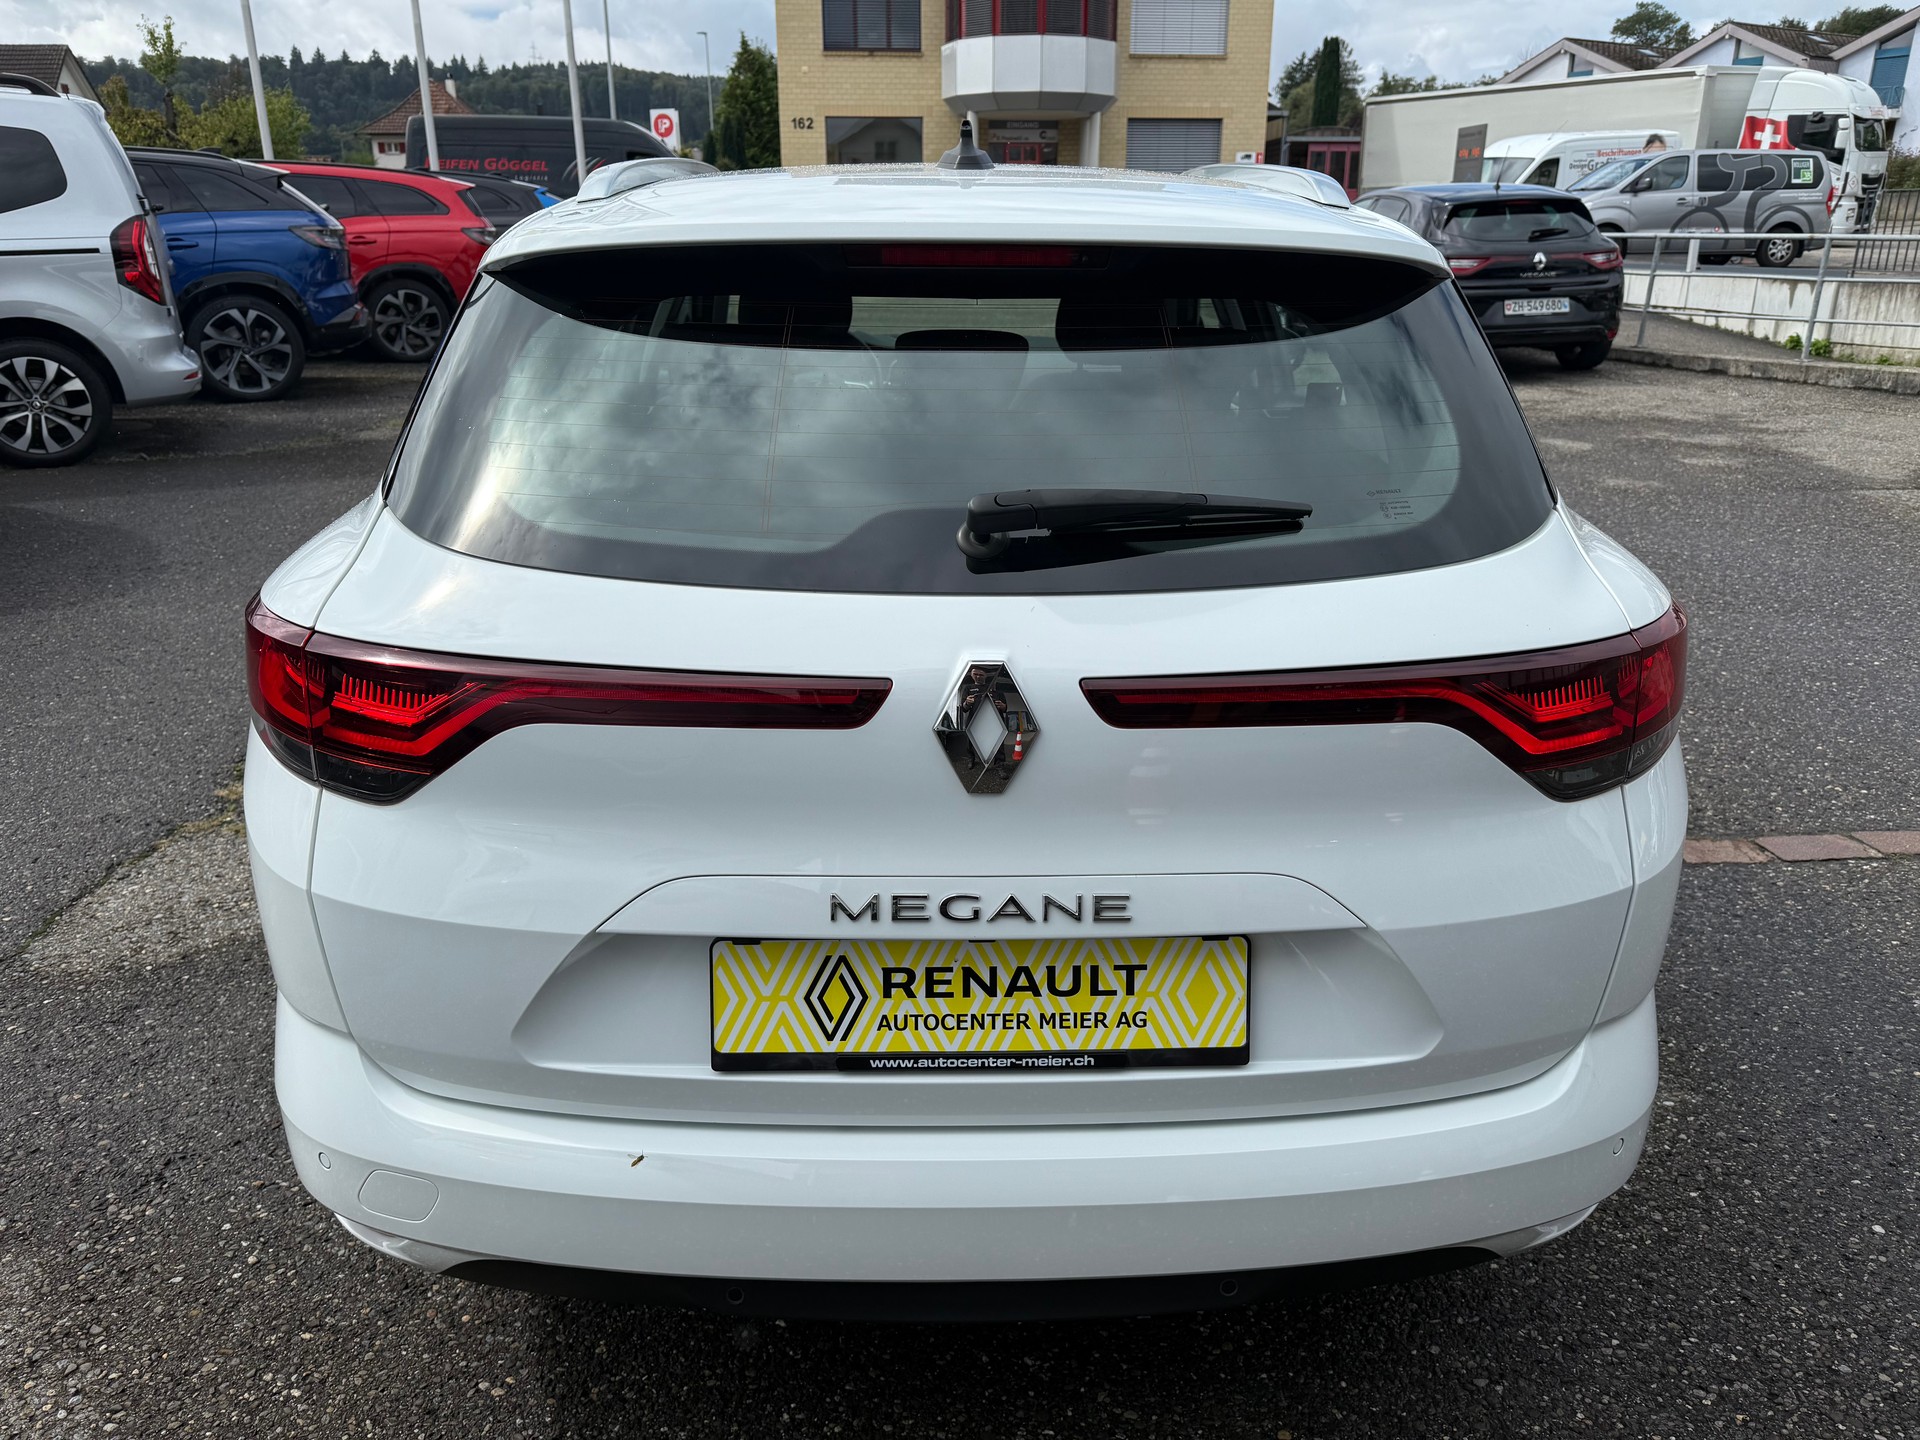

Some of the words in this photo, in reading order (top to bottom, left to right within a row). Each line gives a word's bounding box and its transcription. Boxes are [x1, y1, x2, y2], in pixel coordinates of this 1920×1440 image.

[791, 117, 814, 129] 162
[484, 157, 548, 172] GÖGGEL
[1520, 270, 1557, 278] MEGANE
[829, 892, 1133, 923] MEGANE
[881, 964, 1148, 999] RENAULT
[876, 1012, 1030, 1032] AUTOCENTER
[1039, 1011, 1109, 1030] MEIER
[1116, 1010, 1149, 1029] AG
[869, 1055, 1095, 1069] www.autocenter-meier.ch
